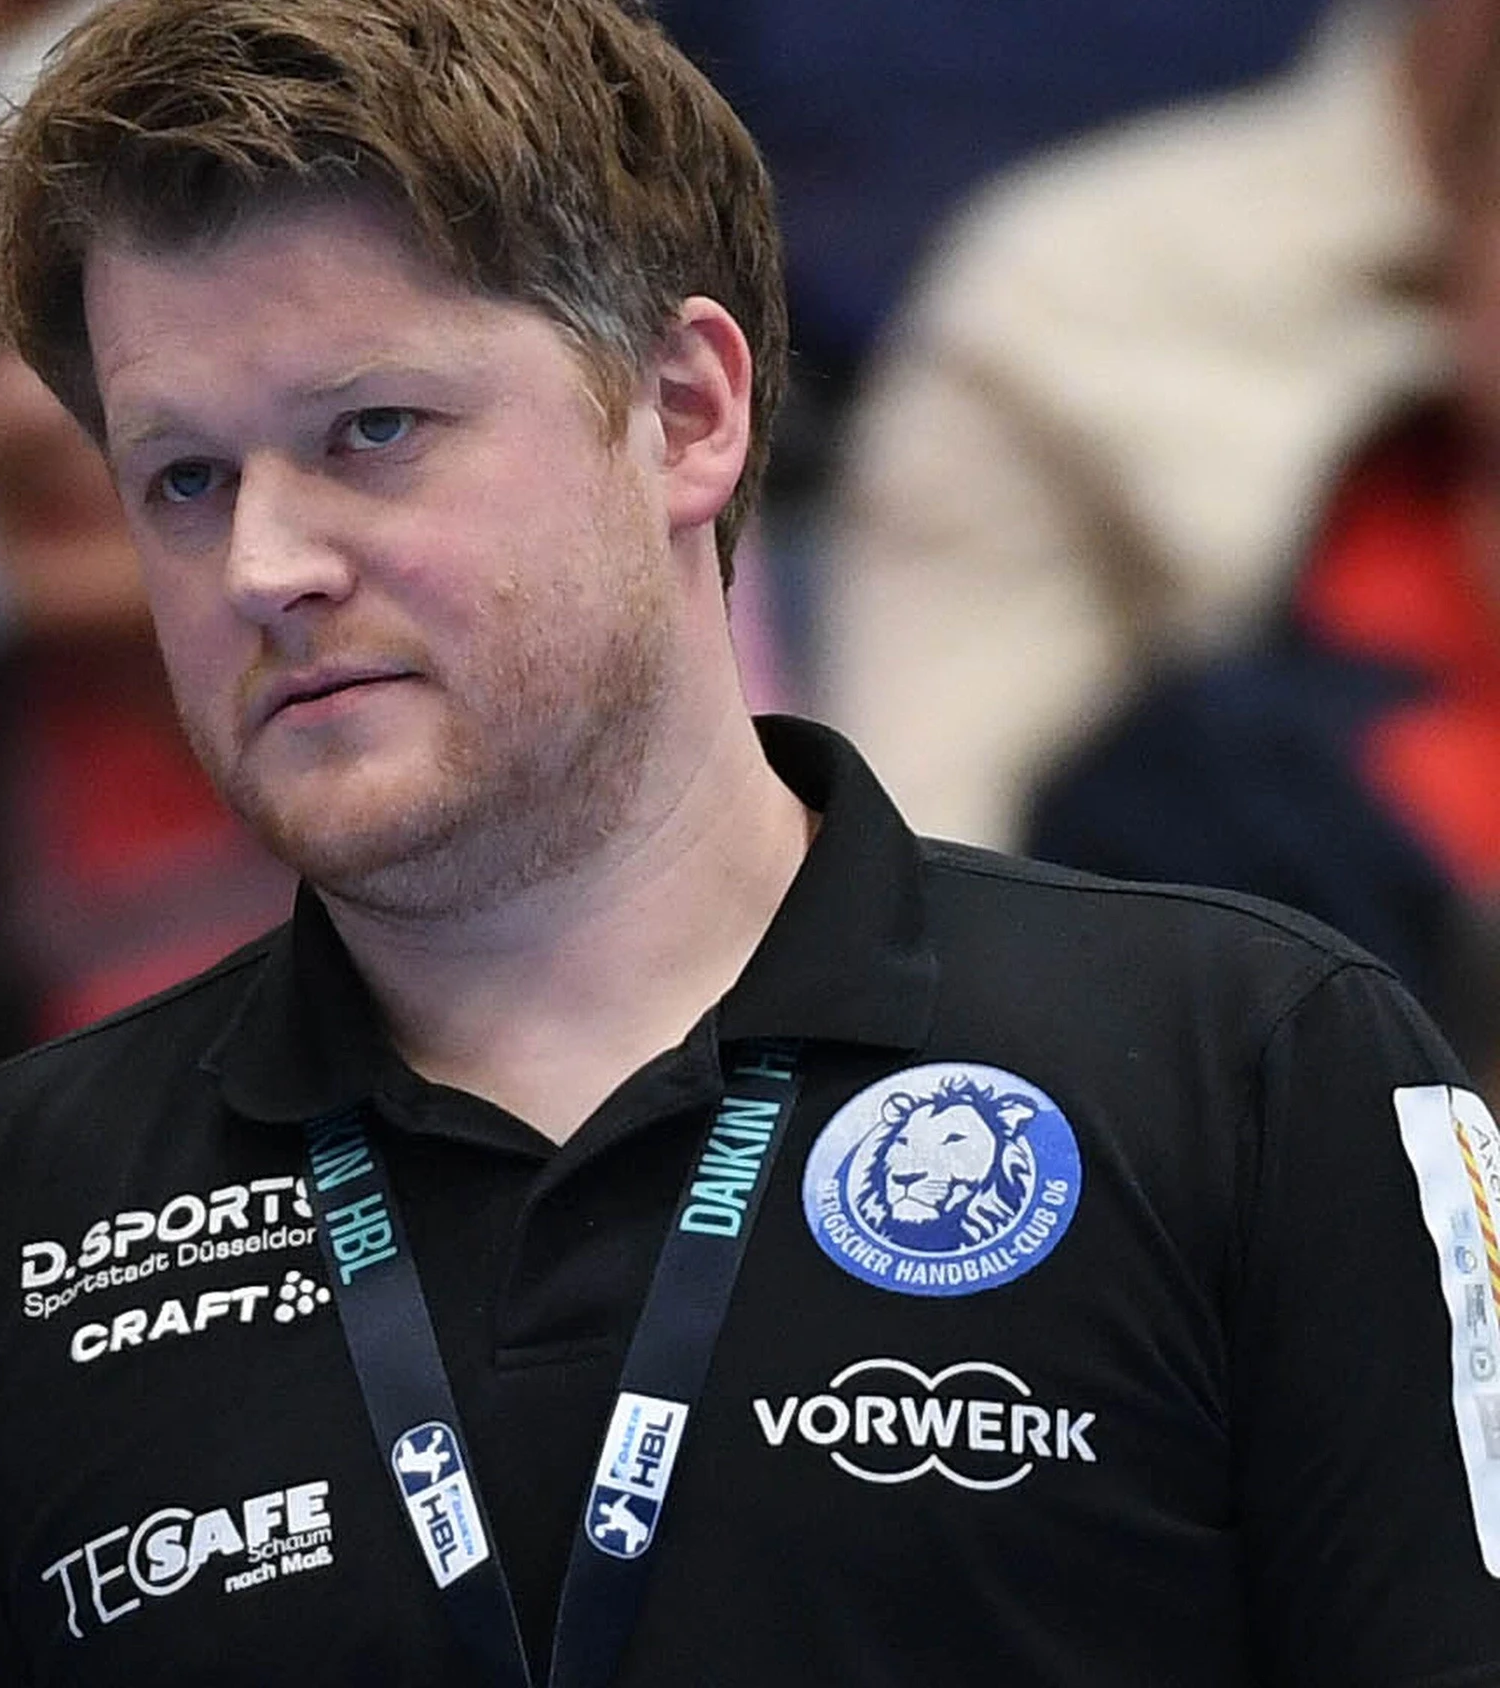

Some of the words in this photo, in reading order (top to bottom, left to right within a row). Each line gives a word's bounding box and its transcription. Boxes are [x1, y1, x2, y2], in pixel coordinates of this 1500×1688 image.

[678, 1095, 781, 1238] DAIKIN
[324, 1193, 397, 1286] HBL
[894, 1206, 1059, 1286] HANDBALL-CLUB
[1041, 1178, 1069, 1206] 06
[23, 1253, 170, 1319] Sportstadt
[177, 1226, 318, 1267] Düsseldor
[70, 1285, 270, 1364] CRAFT
[630, 1410, 674, 1489] HBL
[752, 1394, 1097, 1462] VORWERK
[224, 1562, 277, 1593] nach
[281, 1546, 334, 1575] Maß
[247, 1526, 332, 1564] Schaum
[420, 1493, 461, 1574] HBL
